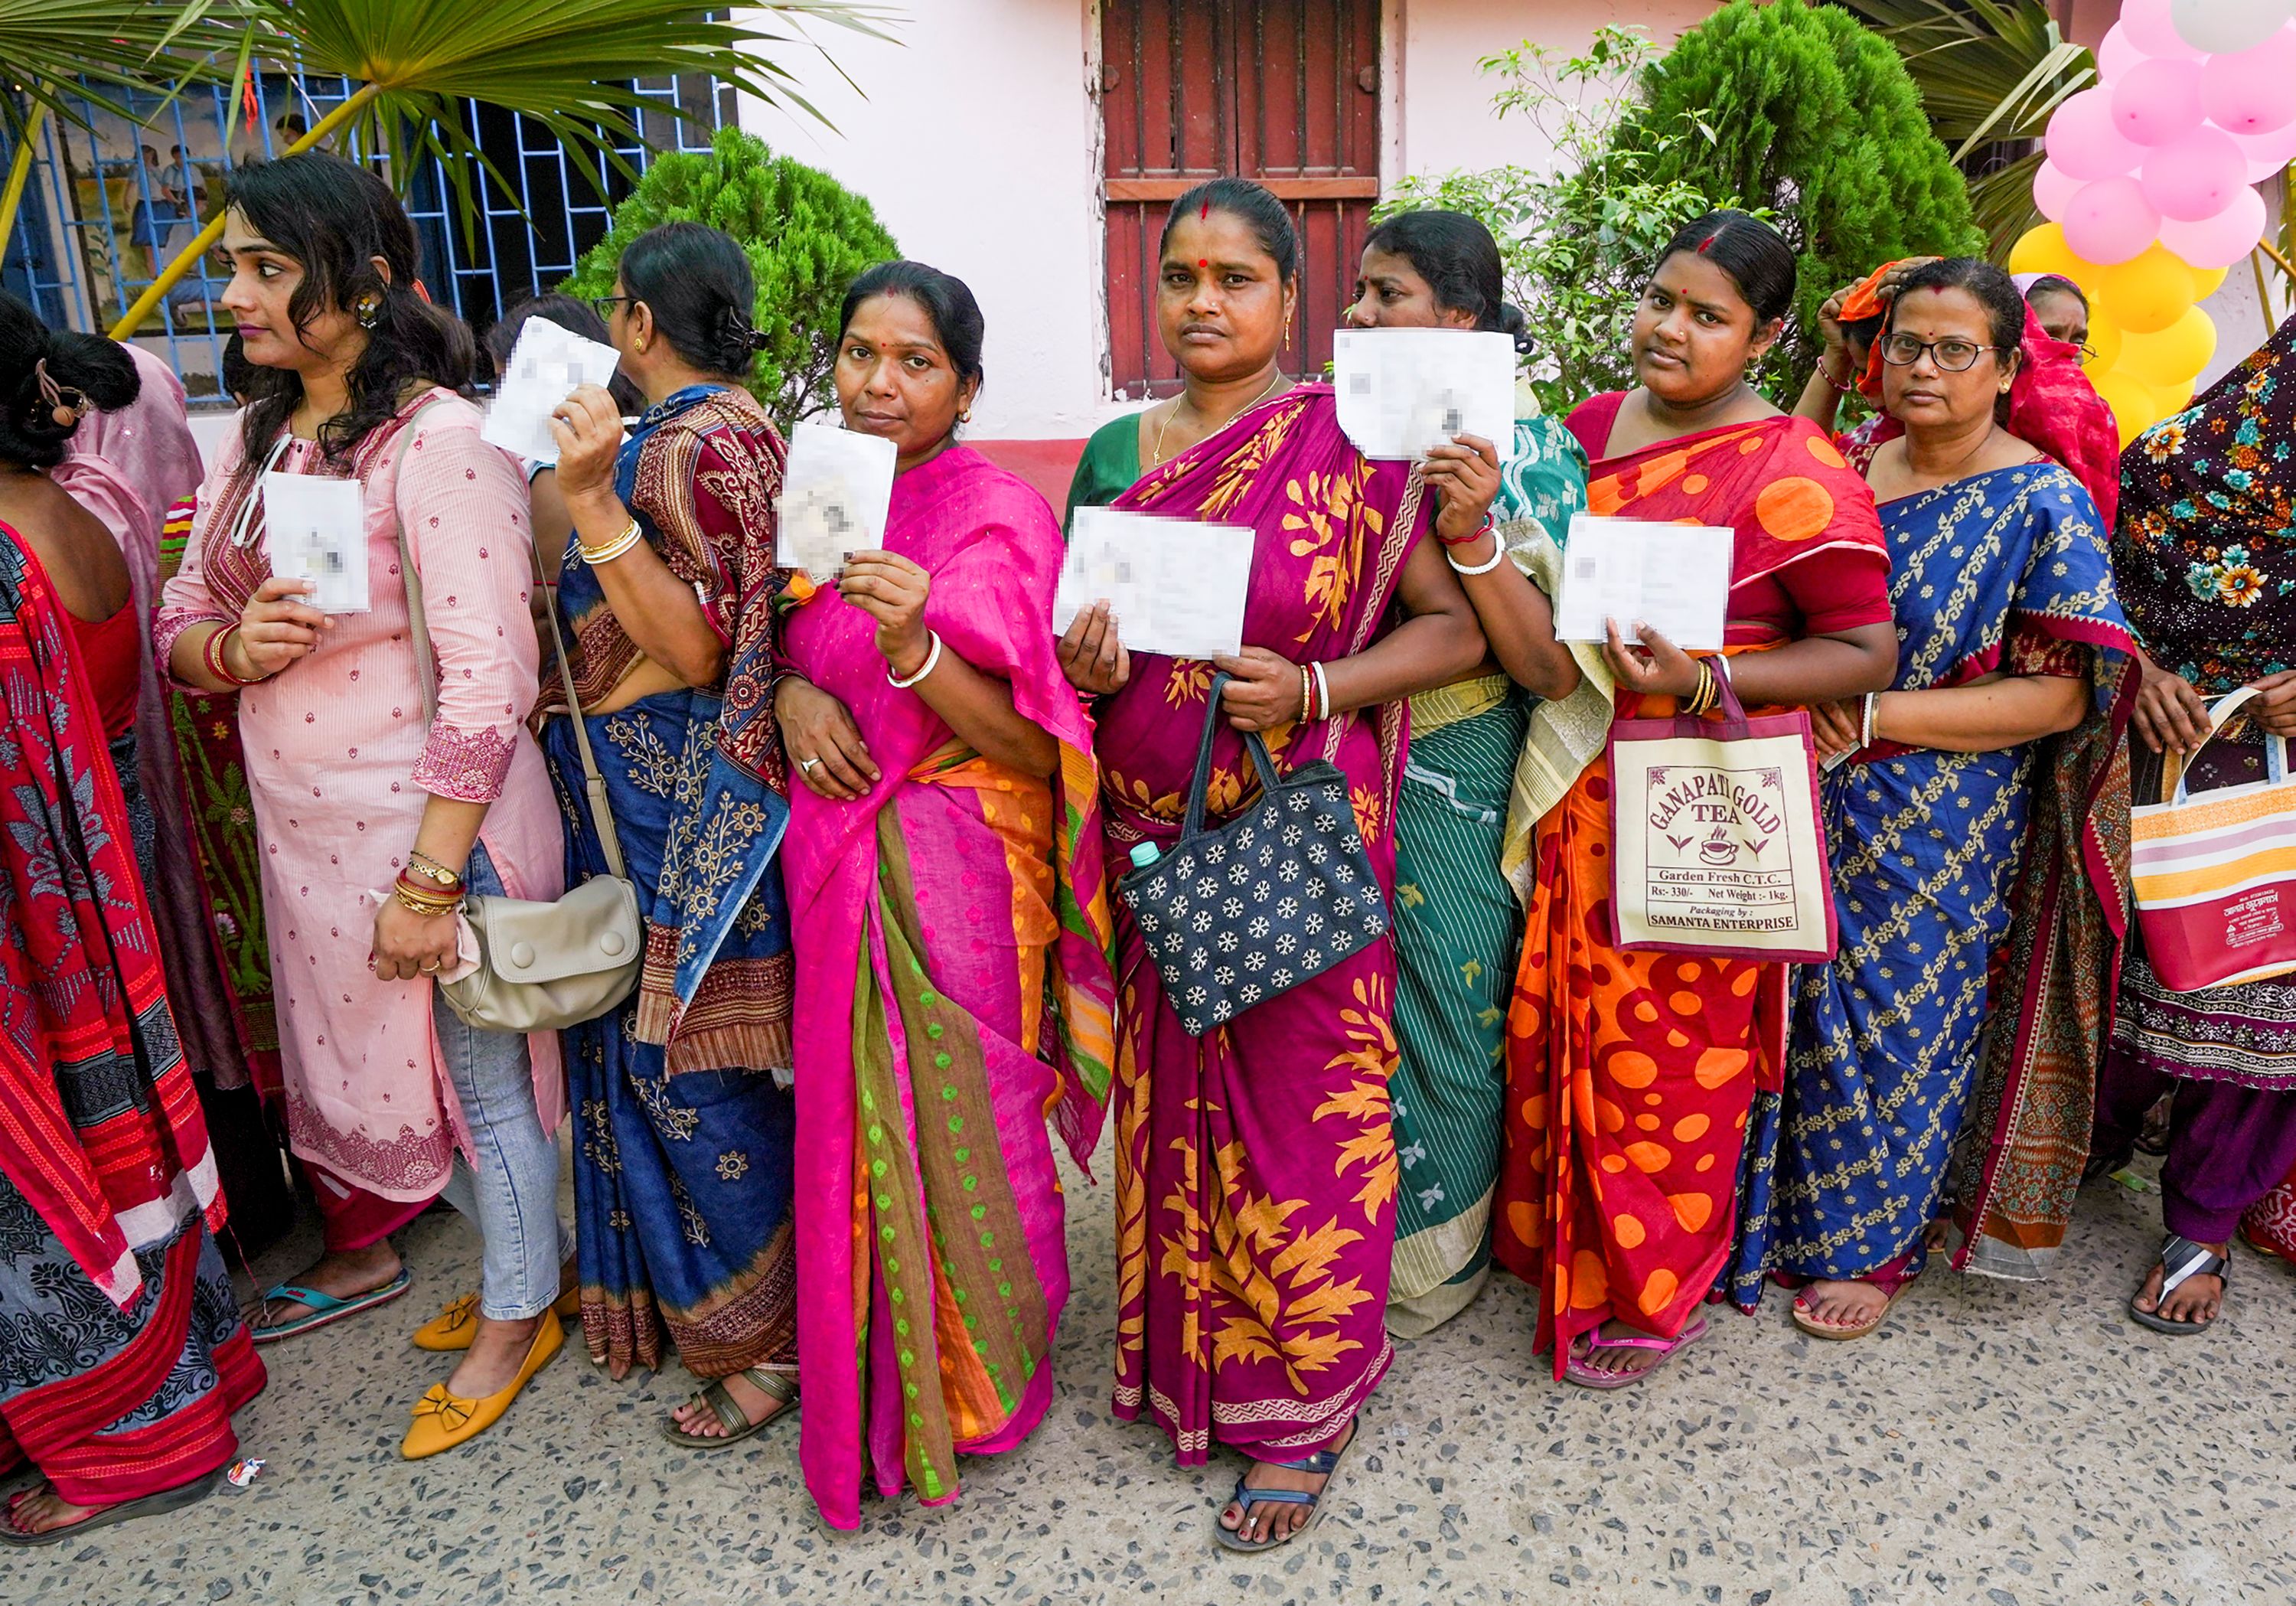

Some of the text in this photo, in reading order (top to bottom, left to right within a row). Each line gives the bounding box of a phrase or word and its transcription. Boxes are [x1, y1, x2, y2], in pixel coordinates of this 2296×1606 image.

[1650, 773, 1781, 834] GANAPATI GOLD
[1691, 805, 1742, 825] TEA
[1659, 870, 1781, 885] Garden Fresh C.T.C.
[1652, 886, 1669, 896] Rs:-
[1671, 886, 1693, 897] 330/-
[1708, 889, 1724, 899] Net
[1727, 889, 1756, 903] Weight
[1769, 890, 1789, 901] 1kg.
[1690, 906, 1736, 916] Packaging
[1737, 907, 1746, 918] by
[1651, 915, 1793, 929] SAMANTA ENTERPRISE
